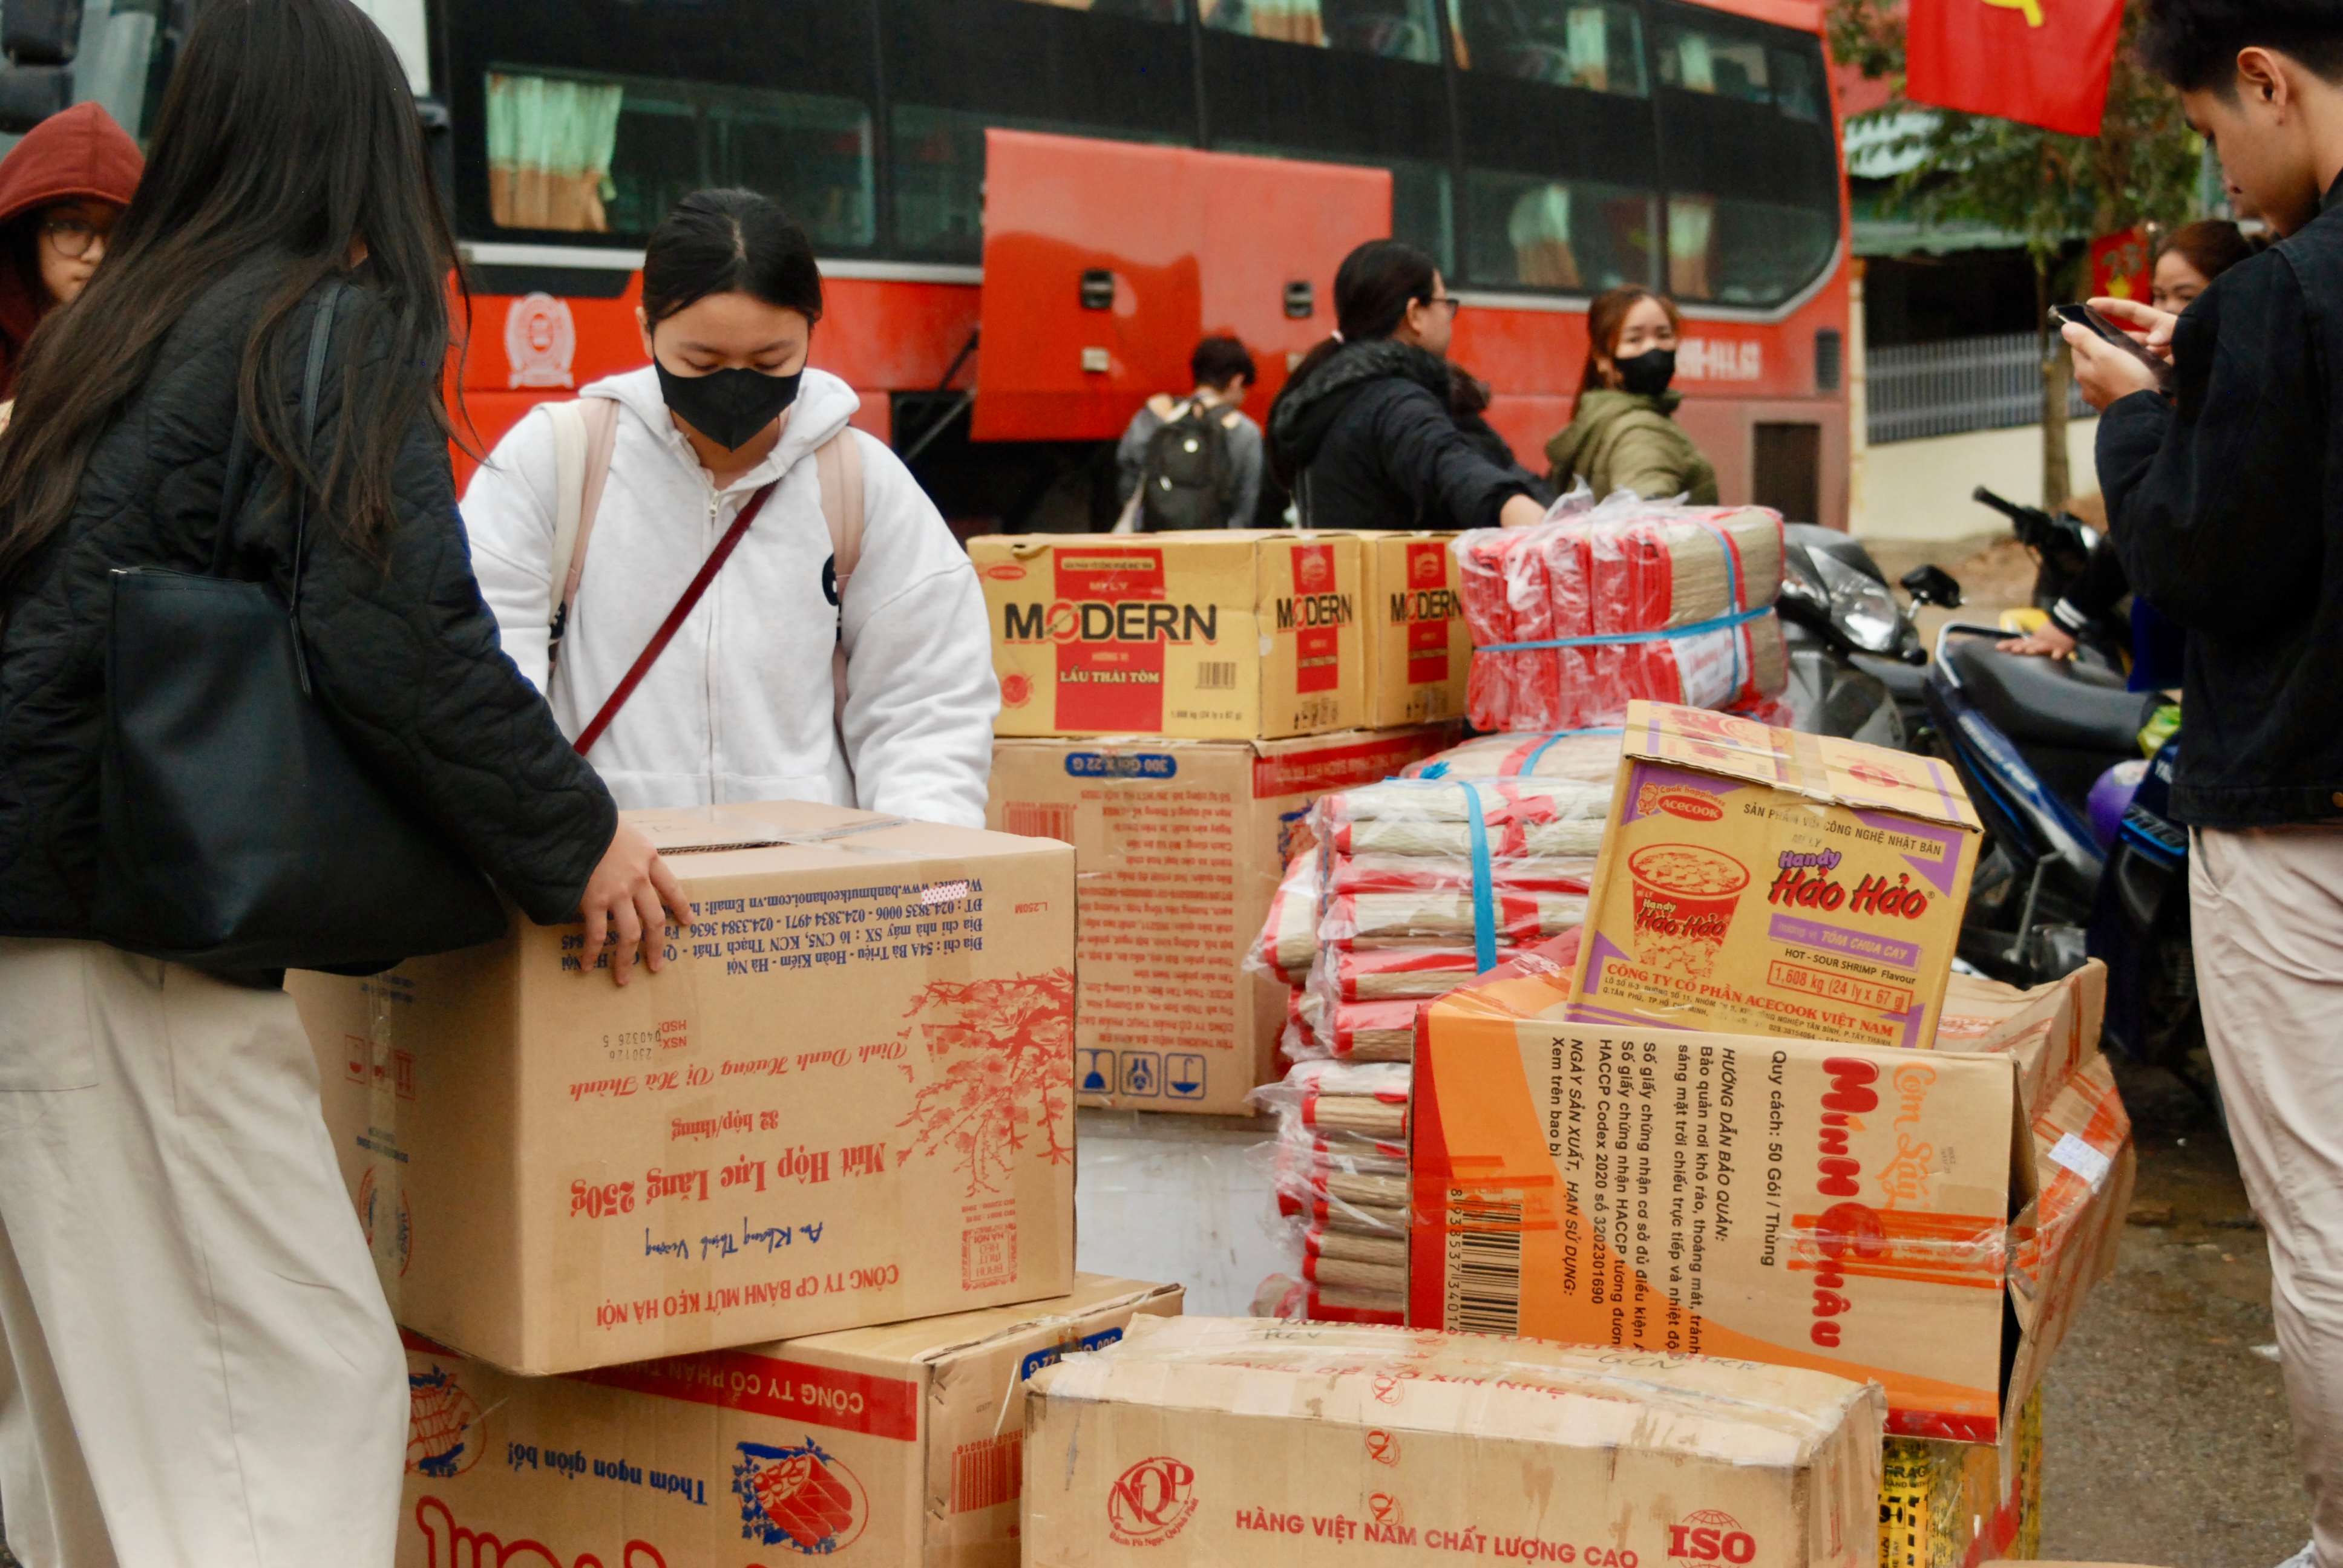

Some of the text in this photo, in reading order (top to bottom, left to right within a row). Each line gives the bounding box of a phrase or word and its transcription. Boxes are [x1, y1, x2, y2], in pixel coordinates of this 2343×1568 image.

[1004, 601, 1217, 641] MODERN
[1277, 594, 1352, 628] MODERN
[1391, 590, 1462, 622] MODERN
[1744, 802, 1765, 817] SẢN
[1855, 829, 1884, 844] NGHỆ
[1888, 835, 1916, 849] NHẬT
[1920, 843, 1941, 855] BẢN
[1778, 847, 1842, 870] Handy
[705, 898, 745, 915] Email:
[965, 899, 983, 912] ĐT
[1642, 898, 1676, 913] Handy
[1767, 866, 1928, 920] Hảo Hảo
[690, 922, 718, 938] 3636
[722, 917, 774, 935] 024.3384
[786, 915, 811, 929] 4971
[815, 909, 865, 926] 024.3834
[876, 906, 903, 920] 0006
[727, 937, 983, 975] Địa chỉ 54A Bà Triệu Hoàn Kiếm Hà Nội
[1785, 949, 1916, 984] HOT SOUR SHRIMP Flavour
[1775, 967, 1807, 987] 1.608
[1810, 974, 1824, 992] kg
[1607, 963, 1649, 981] CÔNG
[1653, 973, 1673, 987] TY
[1744, 995, 1818, 1020] ACECOOK
[1821, 1010, 1857, 1028] VIỆT
[1860, 1019, 1894, 1036] NAM
[570, 1042, 907, 1102] Vinh Danh Hương Vị Hà Thành
[1549, 1037, 1564, 1157] Xem trên bao bì
[671, 1109, 779, 1142] 32 hộp/thùng
[1715, 1048, 1737, 1241] HƯỚNG DẪN BẢO QUẢN:
[1875, 1062, 1937, 1209] Cơm Sấy
[721, 1154, 766, 1192] Lục
[778, 1145, 830, 1184] Hộp
[1562, 1039, 1585, 1296] NGÀY SẢN XUẤT, HẠN SỬ DỤNG:
[1591, 1040, 1612, 1304] HACCP Codex 2020 số 3202301690
[1761, 1051, 1786, 1266] Quy cách: 50 Gói Thùng
[570, 1179, 635, 1219] 250g
[646, 1168, 709, 1205] Lăng
[1632, 1042, 1657, 1337] Số giấy chứng nhận cơ sở đủ kiện
[1665, 1045, 1690, 1349] sáng mặt trời chiếu trực tiếp và nhiệt độ
[1688, 1047, 1714, 1354] Bảo quản nơi khô ráo, thoáng mát, tránh
[743, 1217, 791, 1253] Khang
[799, 1221, 823, 1244] An
[597, 1264, 899, 1331] CÔNG TY CP BÁNH MỨT KẸO HÀ NỘI
[768, 1378, 795, 1402] TY
[801, 1383, 864, 1415] CÔNG
[544, 1450, 707, 1506] Thơm ngon giòn
[1236, 1505, 1640, 1568] HÀNG VIỆT NAM CHẤT LƯỢNG CAO
[1667, 1524, 1756, 1564] ISO
